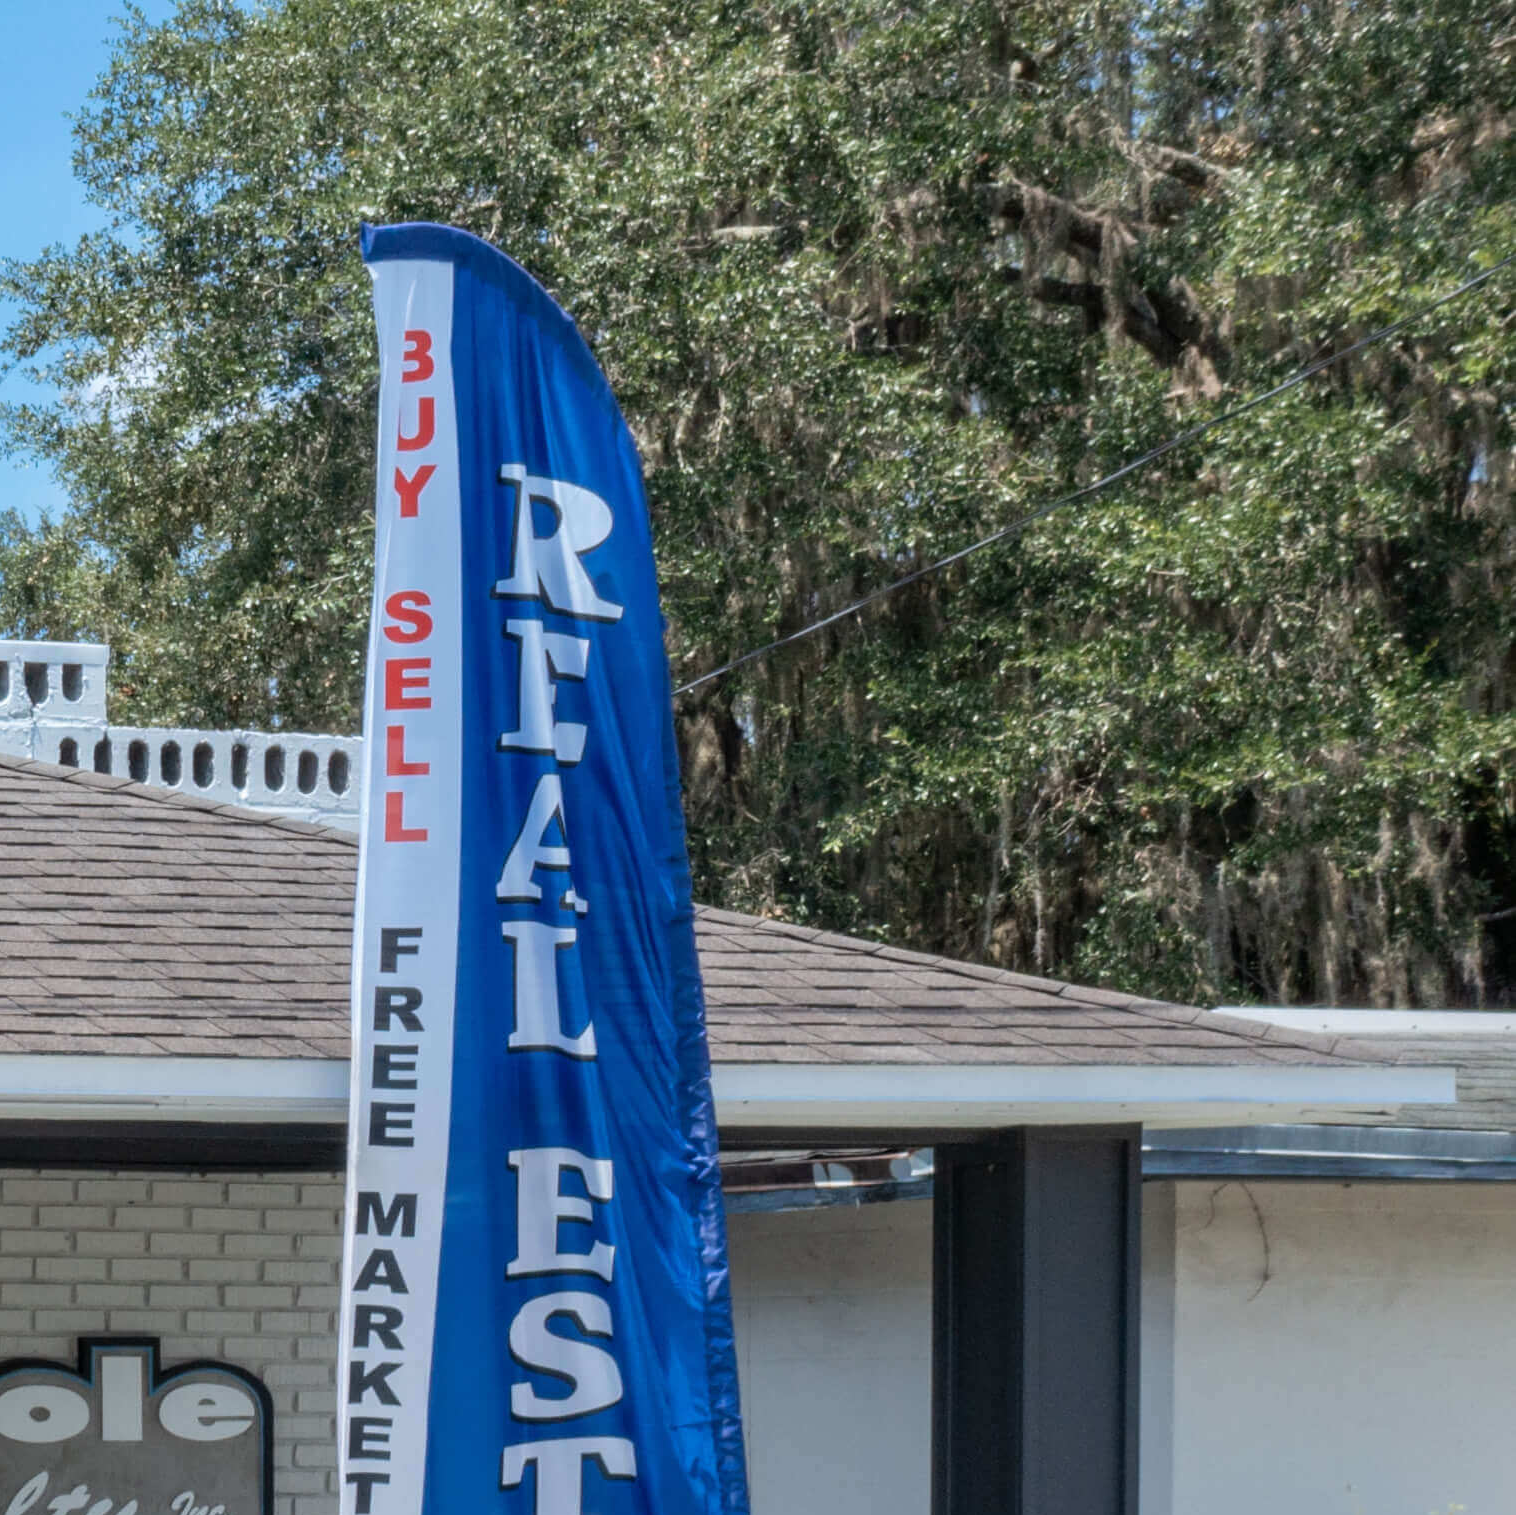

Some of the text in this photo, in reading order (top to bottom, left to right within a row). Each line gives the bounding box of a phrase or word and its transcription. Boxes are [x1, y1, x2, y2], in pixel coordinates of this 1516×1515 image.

[394, 330, 436, 518] BUY
[383, 591, 433, 842] SELL
[492, 463, 624, 1061] REAL
[368, 927, 425, 1148] FREE
[344, 1191, 418, 1515] MARKET
